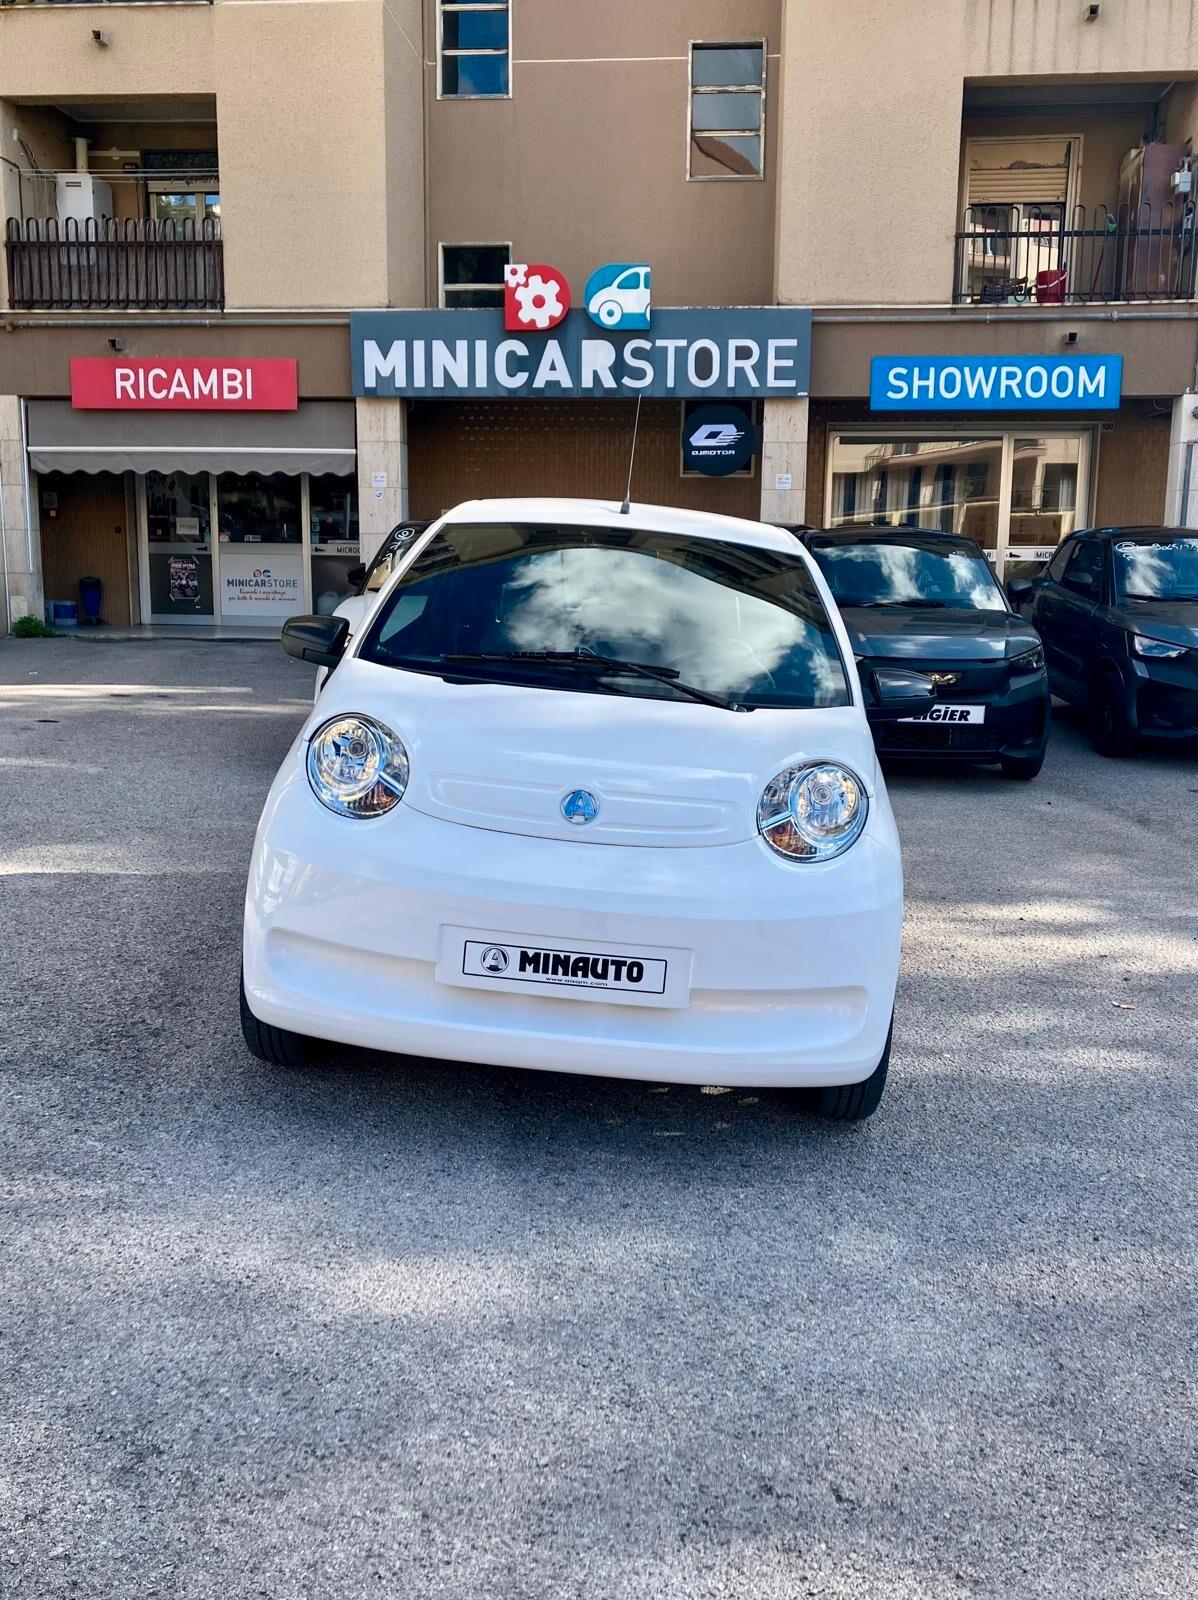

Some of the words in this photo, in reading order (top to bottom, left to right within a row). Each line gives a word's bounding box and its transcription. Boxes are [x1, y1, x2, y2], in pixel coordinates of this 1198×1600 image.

[363, 338, 797, 389] MINICARSTORE
[114, 367, 253, 400] RICAMBI
[886, 365, 1107, 400] SHOWROOM
[226, 578, 299, 588] MINICARSTORE
[518, 950, 645, 983] MINAUTO
